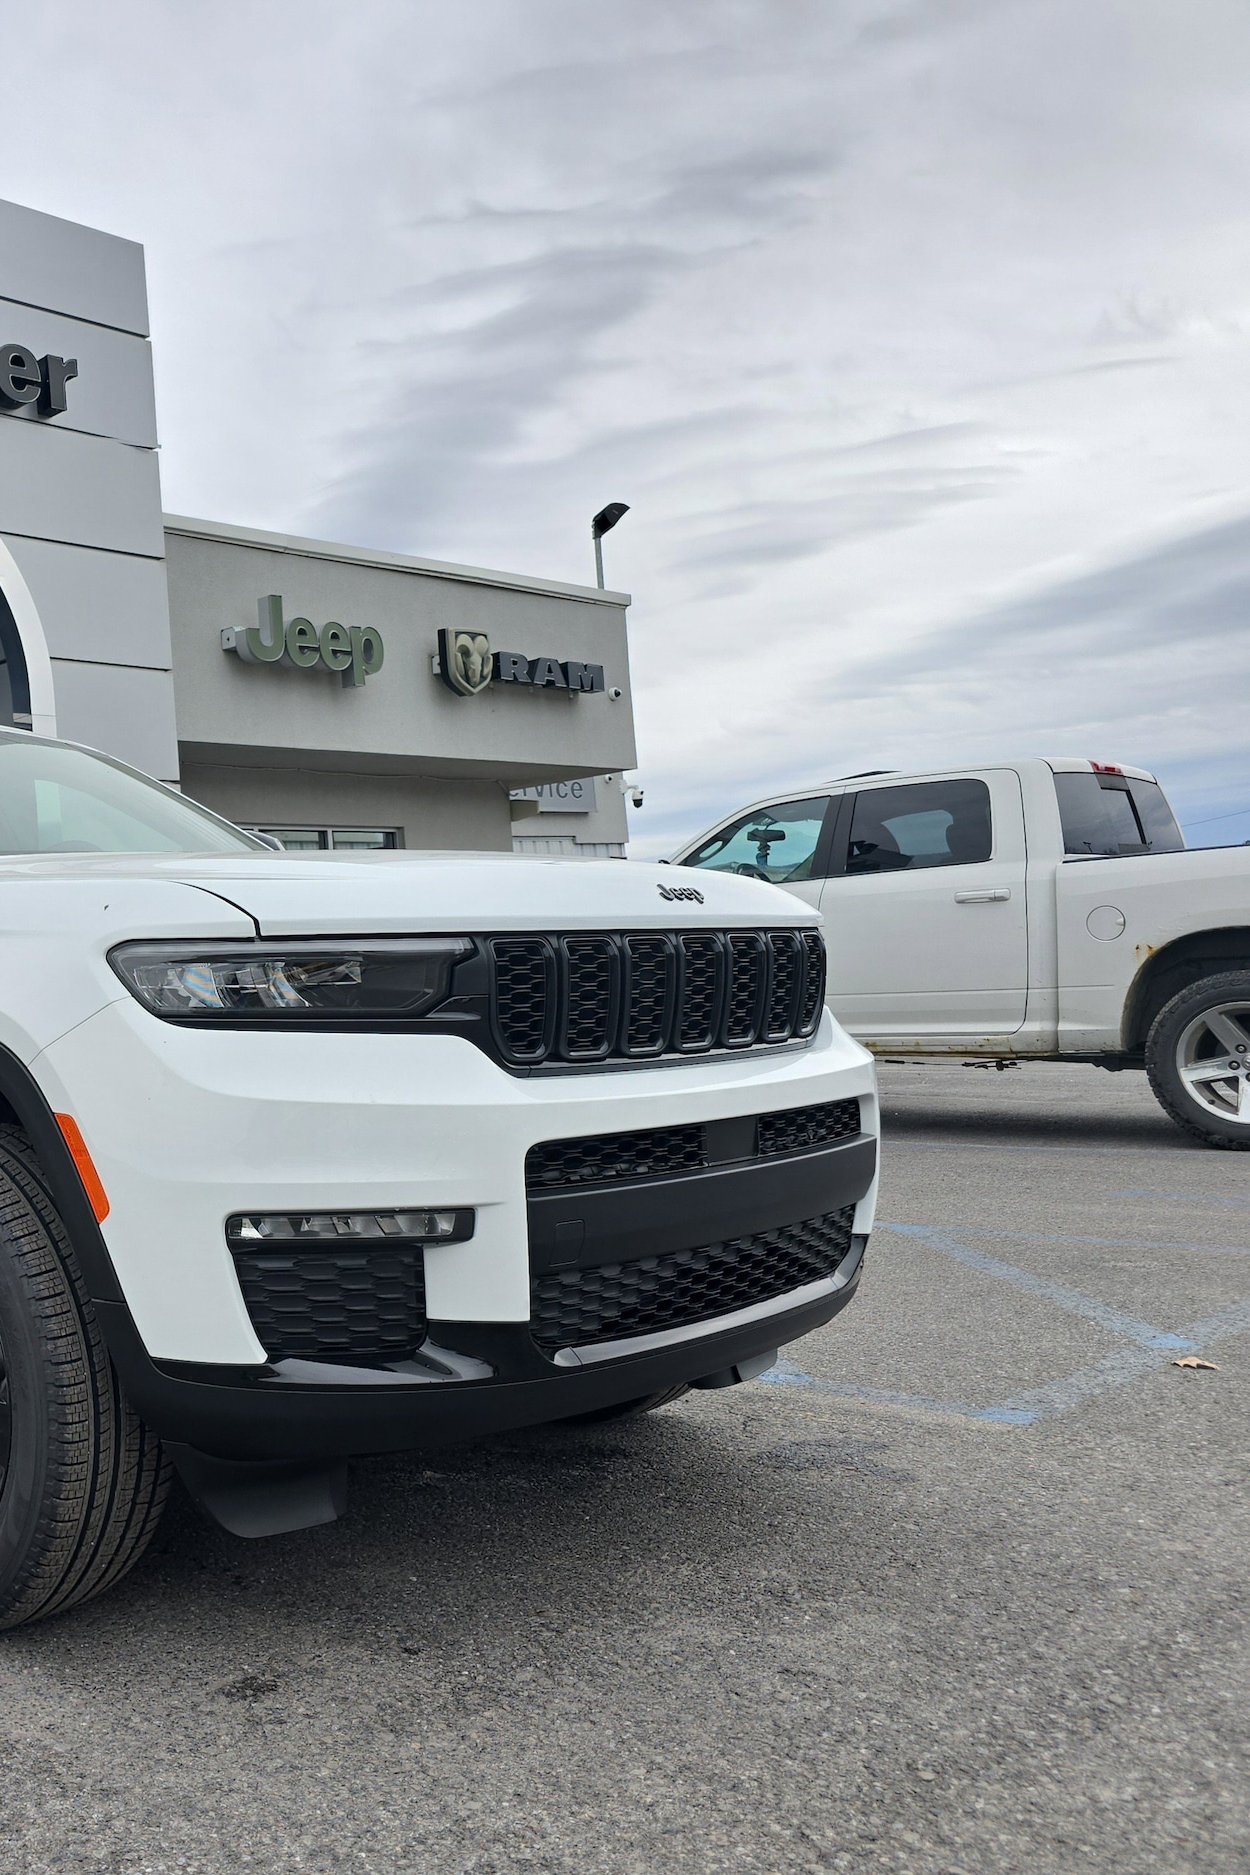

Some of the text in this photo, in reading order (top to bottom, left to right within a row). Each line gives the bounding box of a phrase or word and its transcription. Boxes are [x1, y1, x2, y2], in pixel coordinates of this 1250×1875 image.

[235, 594, 385, 688] Jeep
[491, 650, 605, 694] RAM
[656, 883, 705, 905] Jeep
